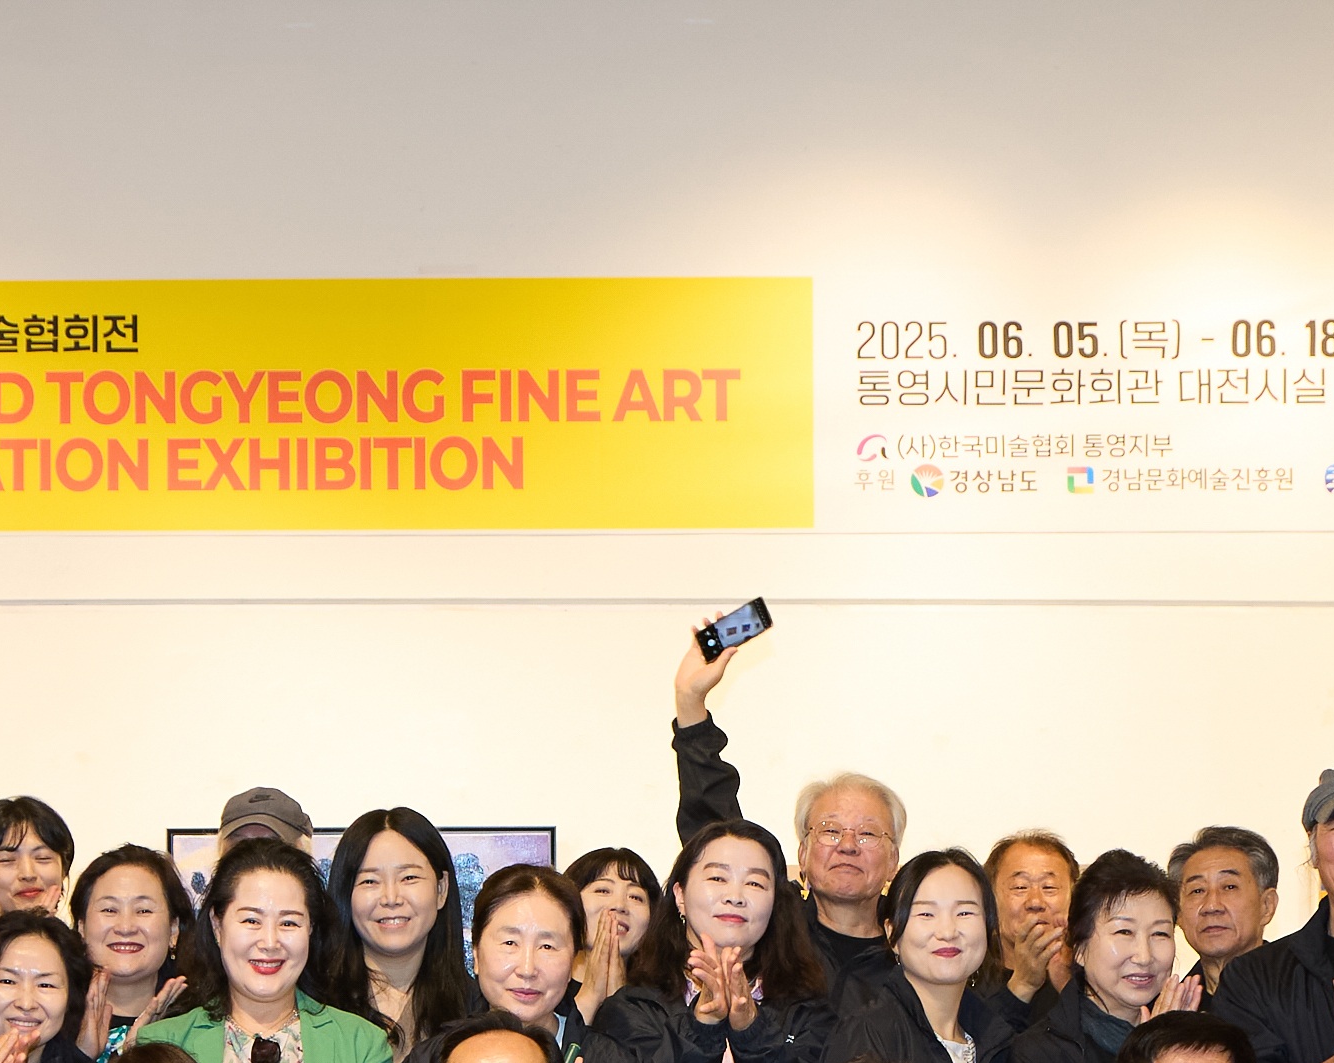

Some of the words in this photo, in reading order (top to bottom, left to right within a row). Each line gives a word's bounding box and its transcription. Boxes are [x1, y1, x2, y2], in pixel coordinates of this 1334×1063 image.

[856, 320, 957, 360] 2025.
[977, 320, 1033, 360] 06.
[1231, 318, 1286, 358] 06.
[45, 368, 445, 425] TONGYEONG
[461, 369, 601, 423] FINE
[612, 369, 741, 422] ART
[856, 367, 1164, 406] 통영시민문화회관
[1178, 367, 1326, 405] 대전시실
[167, 435, 524, 491] EXHIBITION
[897, 433, 1075, 460] (사)한국미술협회
[1082, 433, 1173, 458] 통영지부
[854, 469, 895, 491] 후원
[950, 469, 1038, 493] 경상남도
[1102, 467, 1293, 492] 경남문화예술진흥원
